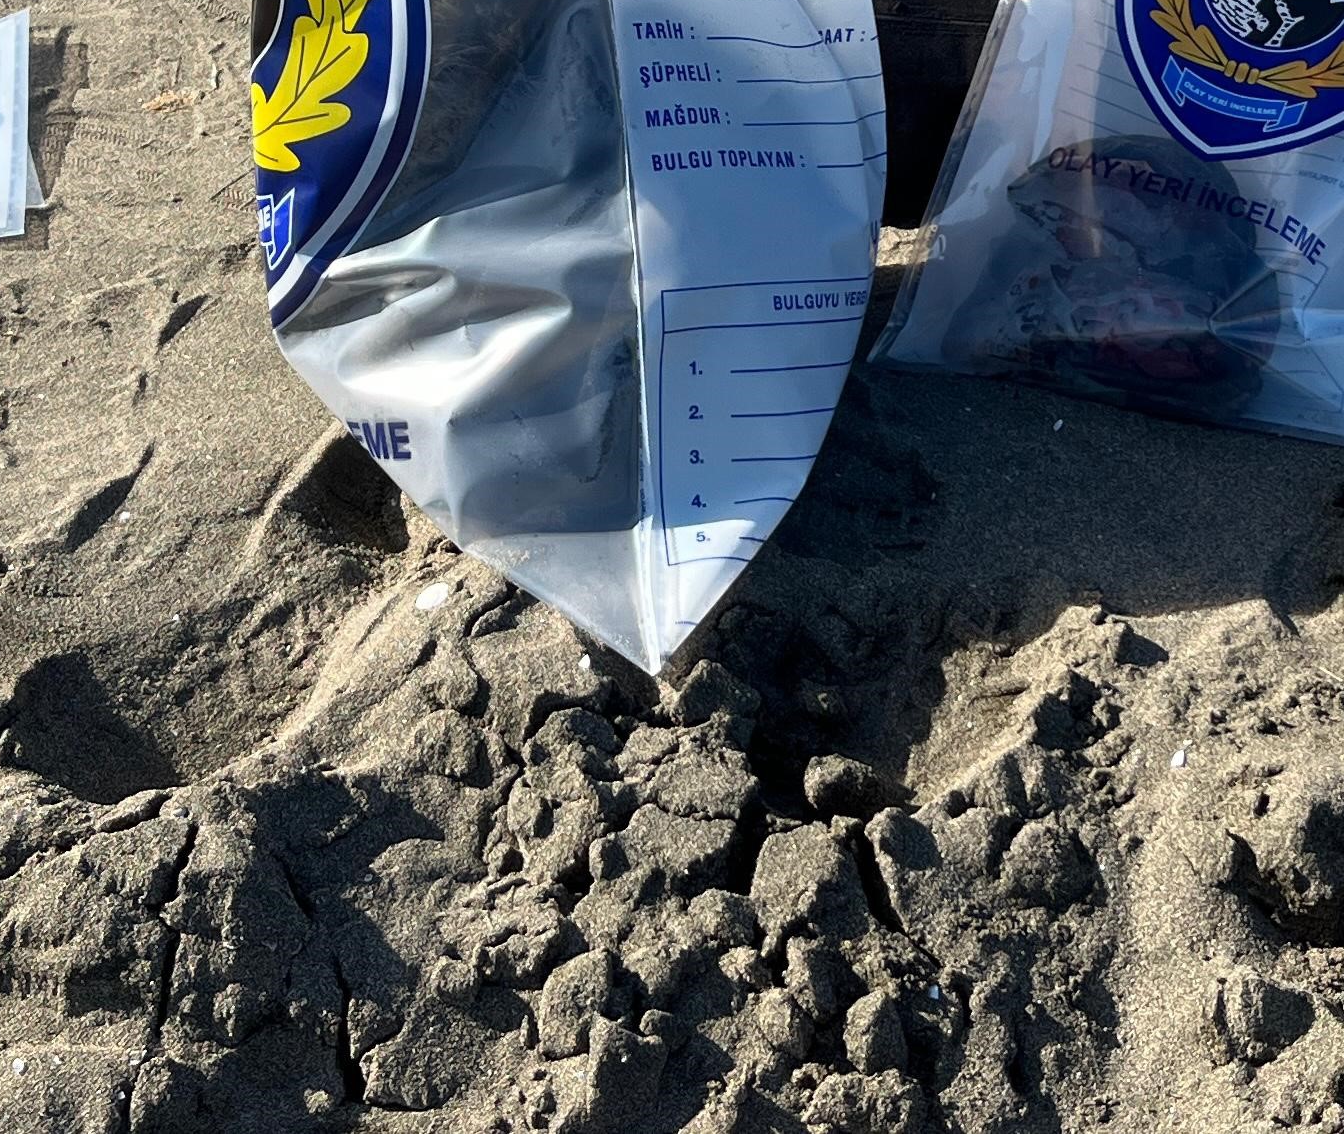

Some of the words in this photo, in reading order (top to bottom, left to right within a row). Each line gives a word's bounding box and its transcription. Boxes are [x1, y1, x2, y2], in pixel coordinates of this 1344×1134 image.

[633, 19, 684, 40] TARİH
[640, 62, 711, 88] ŞÜPHELİ
[1183, 81, 1206, 97] OLAY
[645, 104, 720, 128] MAĞDUR
[651, 151, 712, 172] BULGU
[718, 150, 794, 168] TOPLAYAN
[1048, 147, 1121, 179] OLAY
[1128, 166, 1193, 203] YERİ
[1197, 182, 1326, 266] İNCELEME
[773, 293, 839, 312] BULGUYU
[689, 361, 703, 375] 1.
[689, 405, 704, 420] 2.
[689, 450, 704, 464] 3.
[691, 494, 707, 508] 4.
[696, 532, 710, 542] 5.
